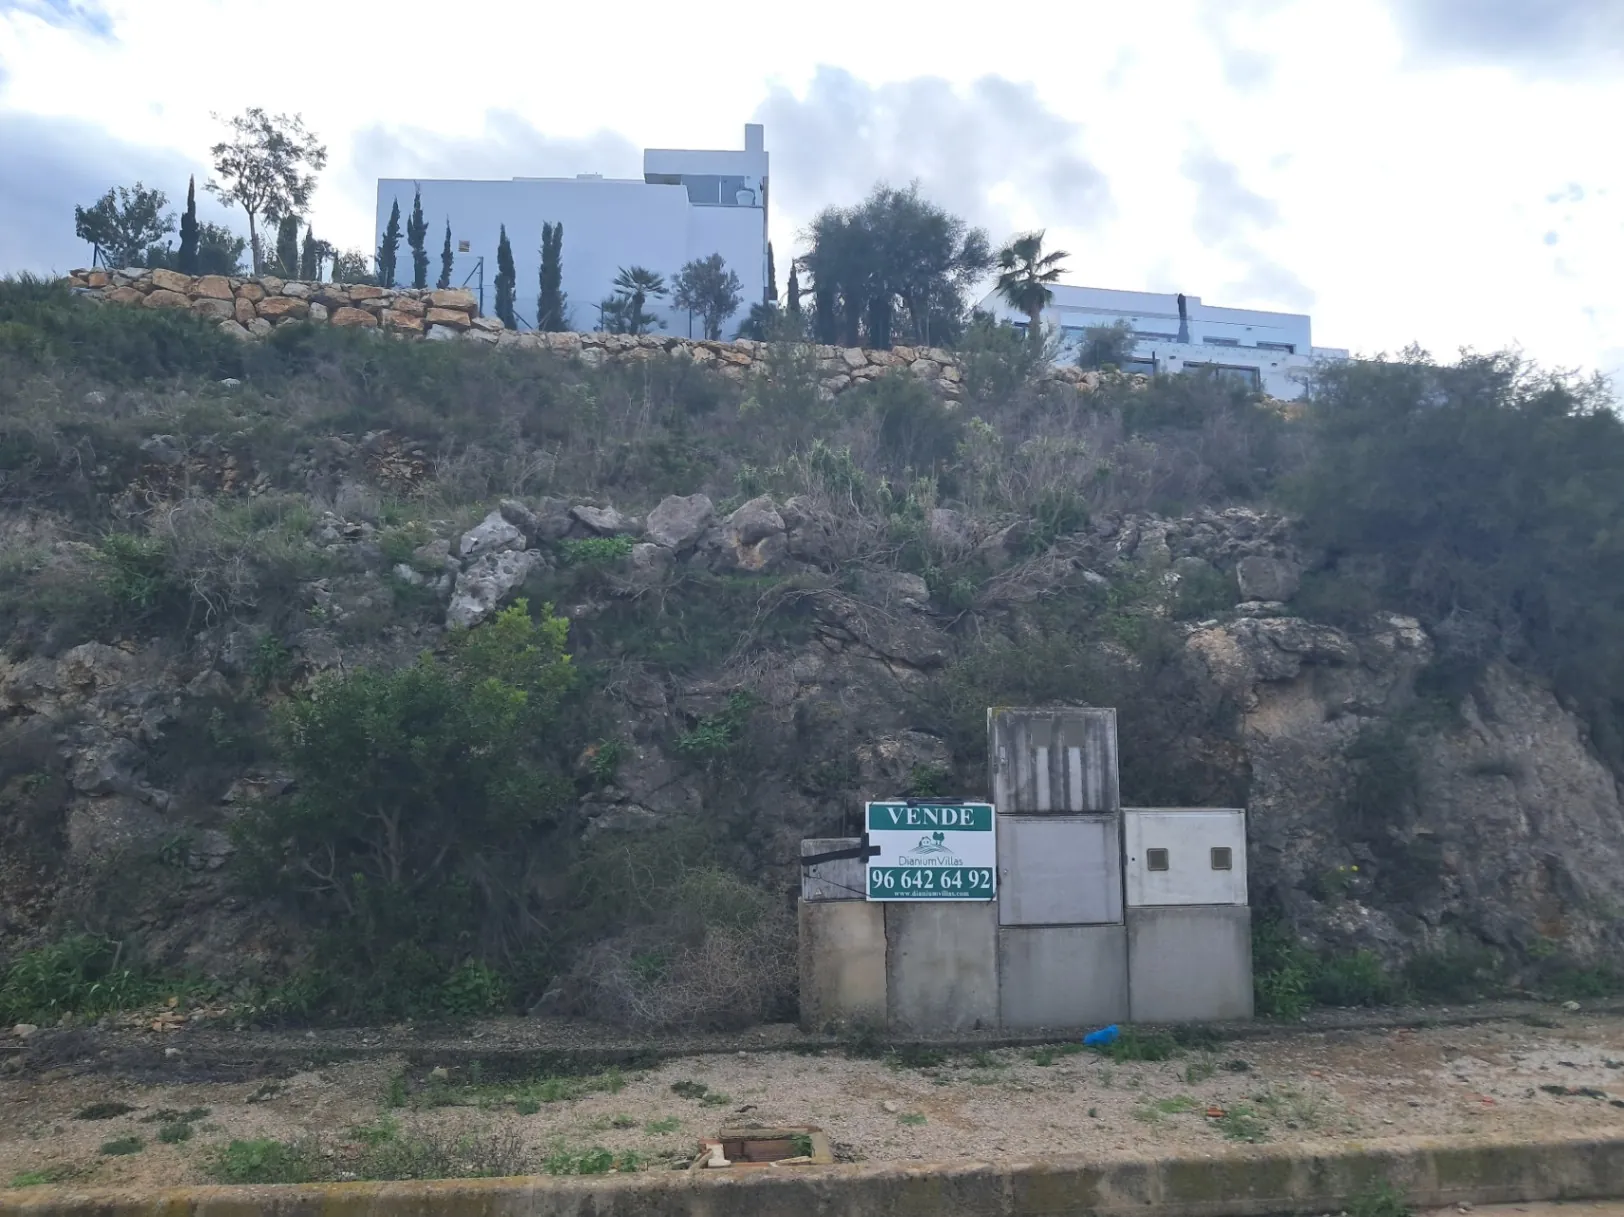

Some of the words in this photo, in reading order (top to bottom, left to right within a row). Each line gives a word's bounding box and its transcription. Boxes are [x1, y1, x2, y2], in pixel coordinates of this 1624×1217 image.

[887, 807, 975, 825] VENDE
[872, 869, 895, 889] 96
[901, 869, 934, 889] 642
[940, 870, 963, 889] 64
[968, 870, 991, 889] 92
